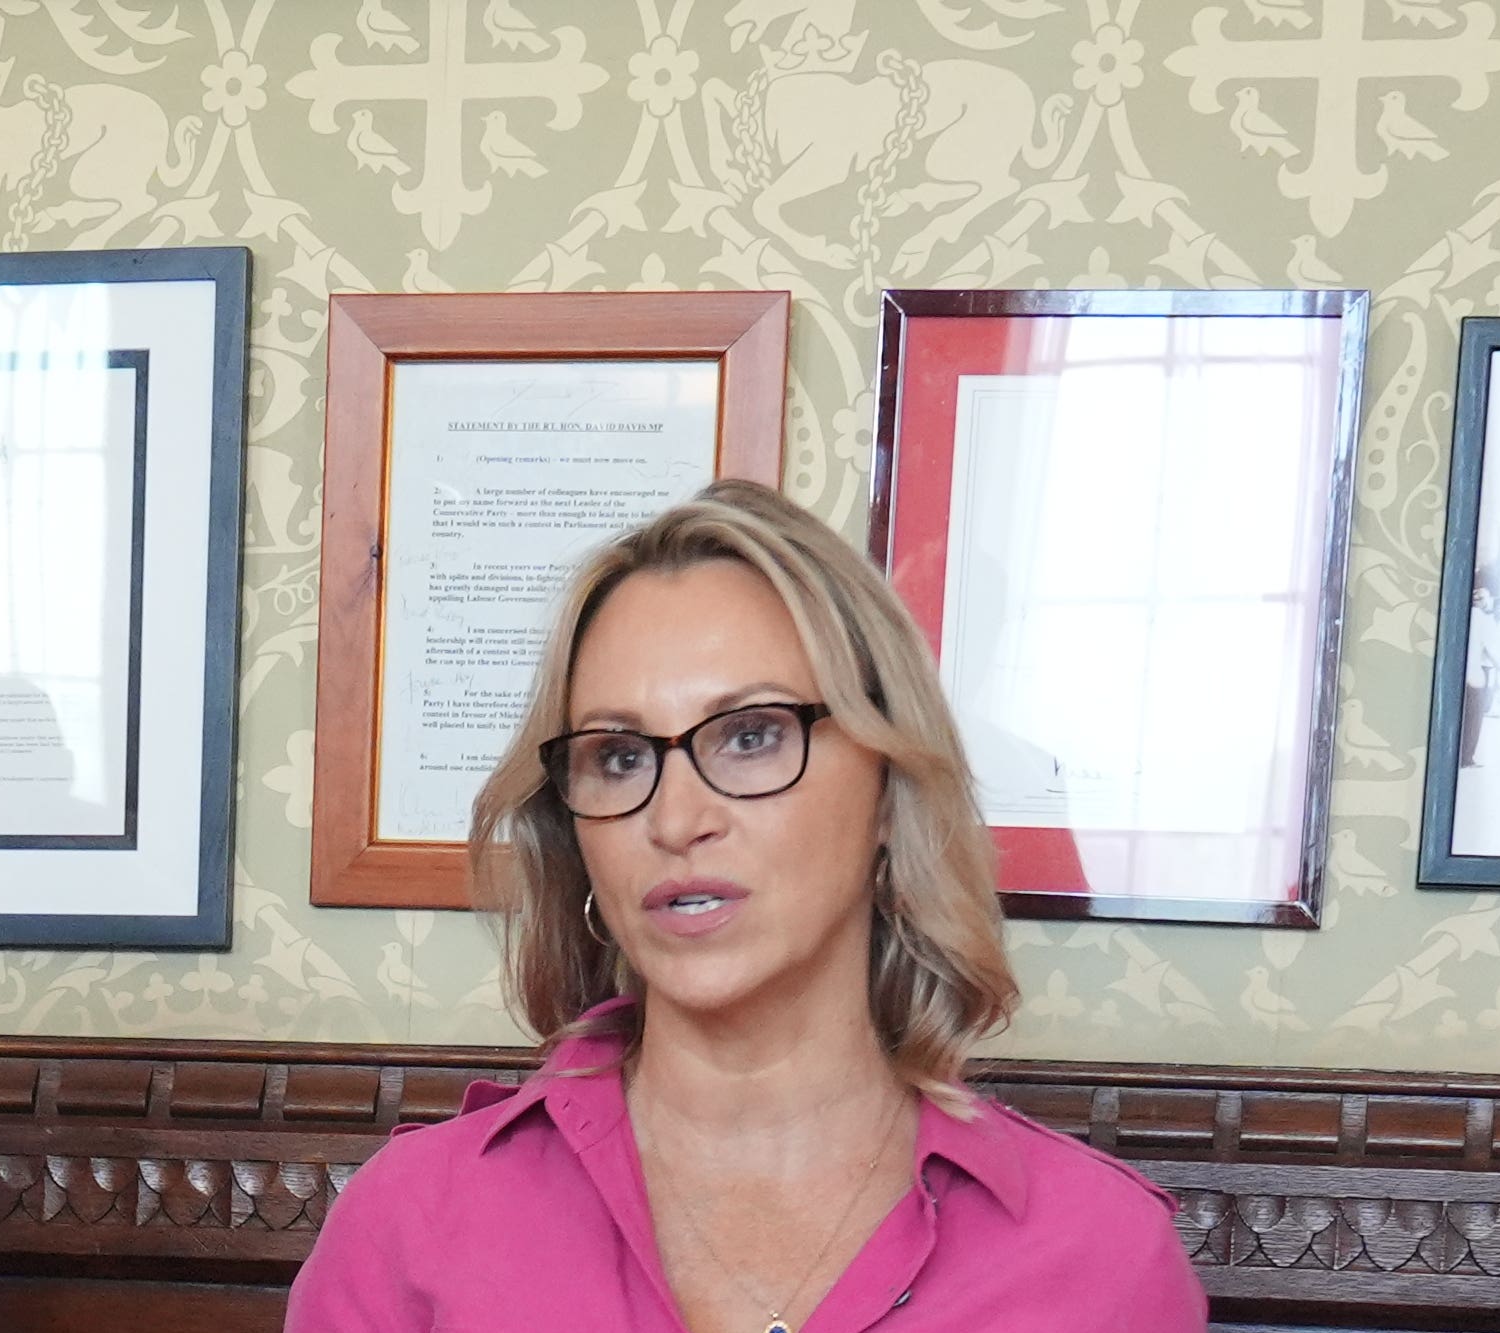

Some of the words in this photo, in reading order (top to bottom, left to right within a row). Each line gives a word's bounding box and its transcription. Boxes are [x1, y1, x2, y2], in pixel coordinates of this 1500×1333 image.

[448, 422, 504, 432] STATEMENT
[508, 423, 520, 432] BY
[522, 423, 540, 432] THE
[586, 423, 616, 432] DAVID
[618, 424, 646, 432] DAVIS
[650, 424, 664, 432] MP
